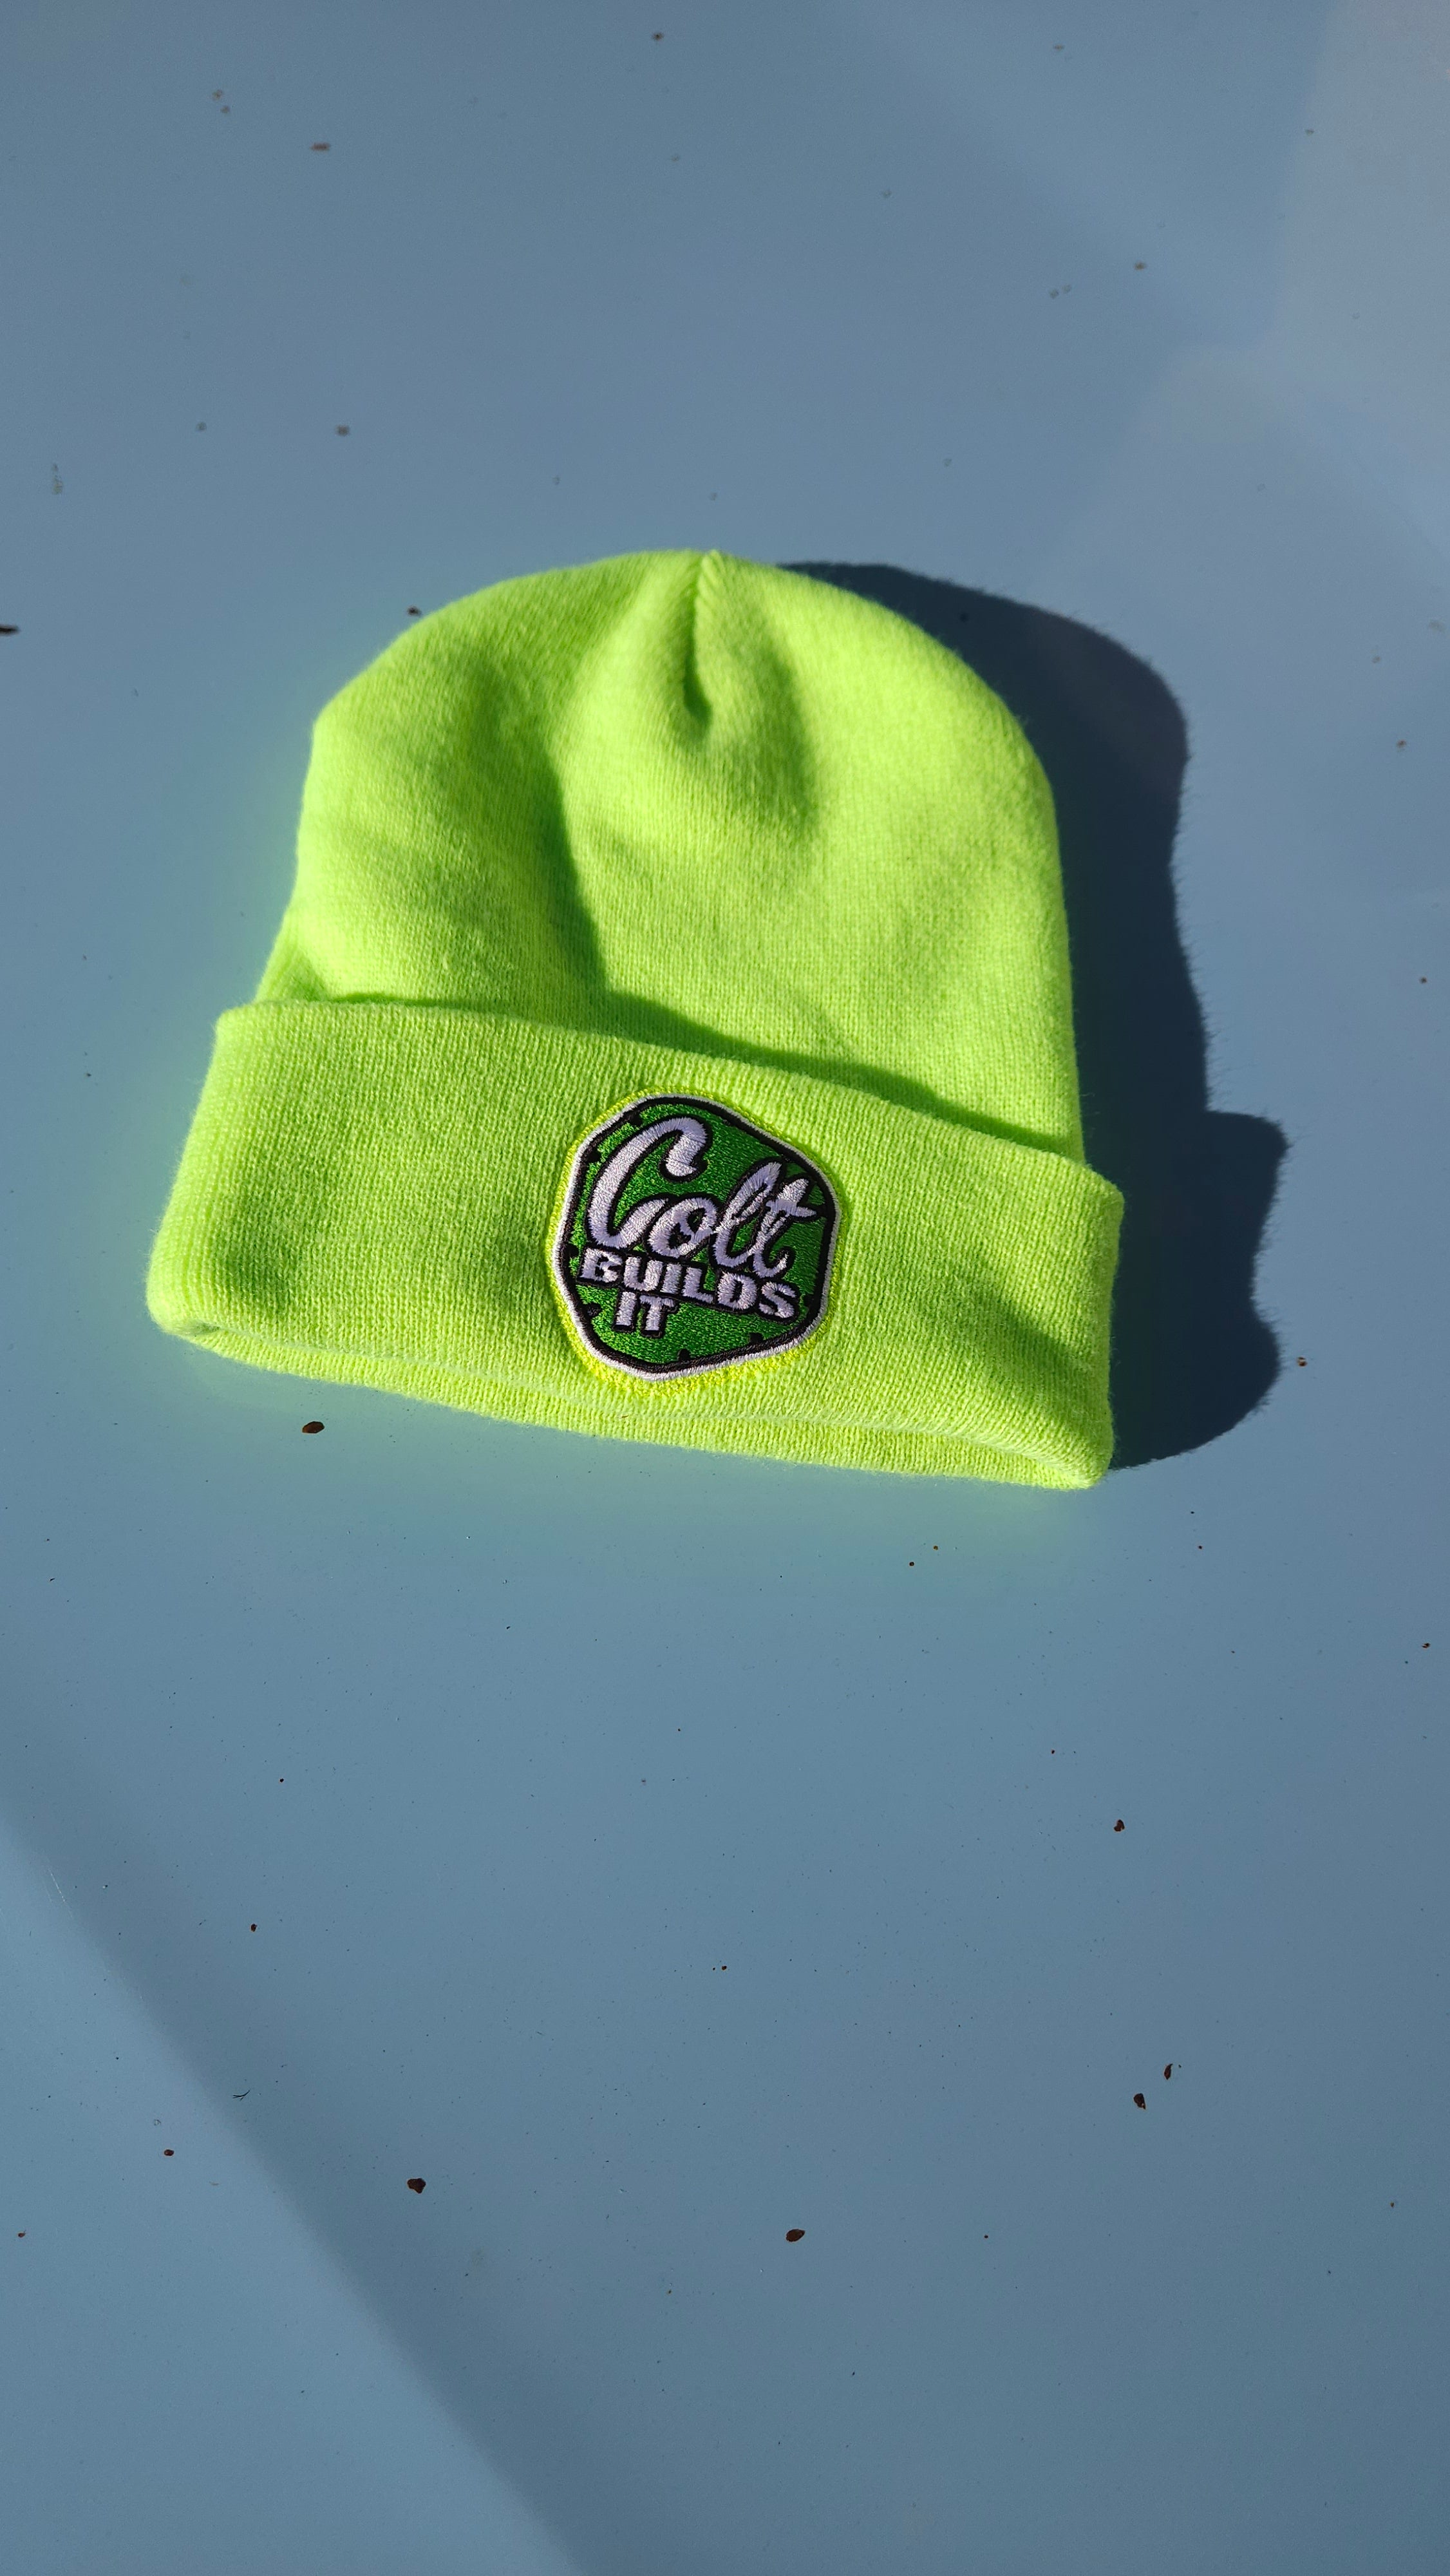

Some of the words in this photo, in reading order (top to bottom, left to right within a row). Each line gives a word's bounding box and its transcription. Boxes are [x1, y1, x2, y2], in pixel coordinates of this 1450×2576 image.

[587, 1115, 818, 1279] Colt
[579, 1246, 798, 1319] BUILDS
[614, 1290, 675, 1332] IT
